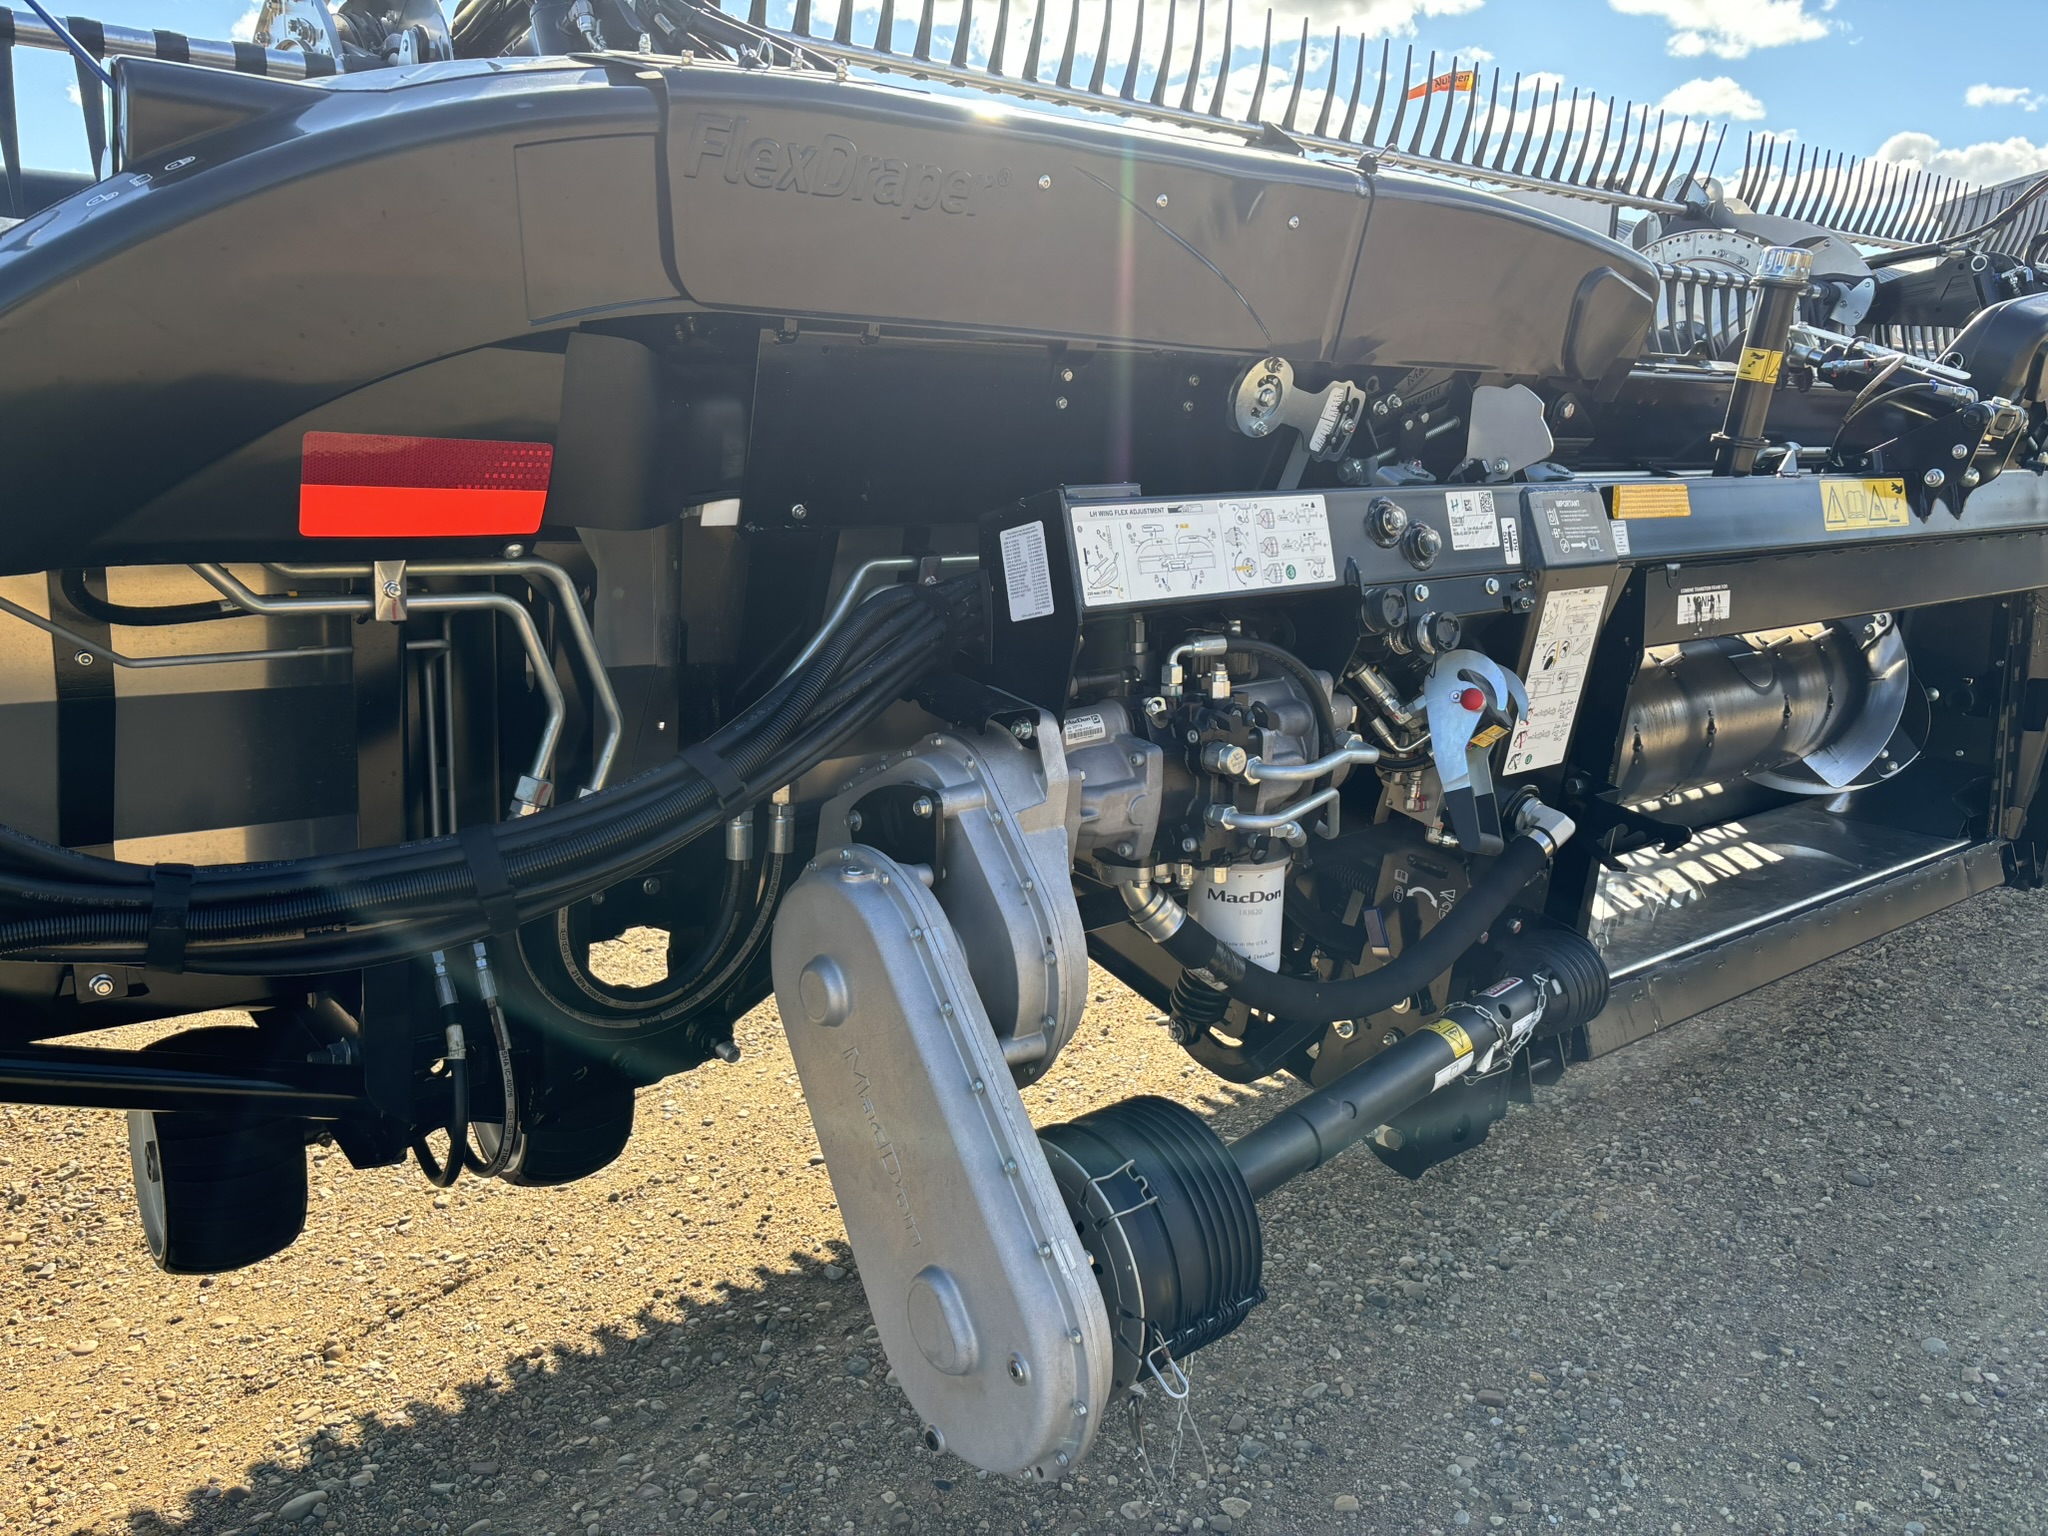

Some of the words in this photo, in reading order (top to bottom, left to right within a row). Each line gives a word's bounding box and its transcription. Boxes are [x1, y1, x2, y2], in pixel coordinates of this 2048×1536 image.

[1089, 510, 1098, 518] LH
[1098, 509, 1114, 517] WING
[1129, 507, 1165, 516] ADJUSTMENT
[1207, 887, 1281, 904] MacDon
